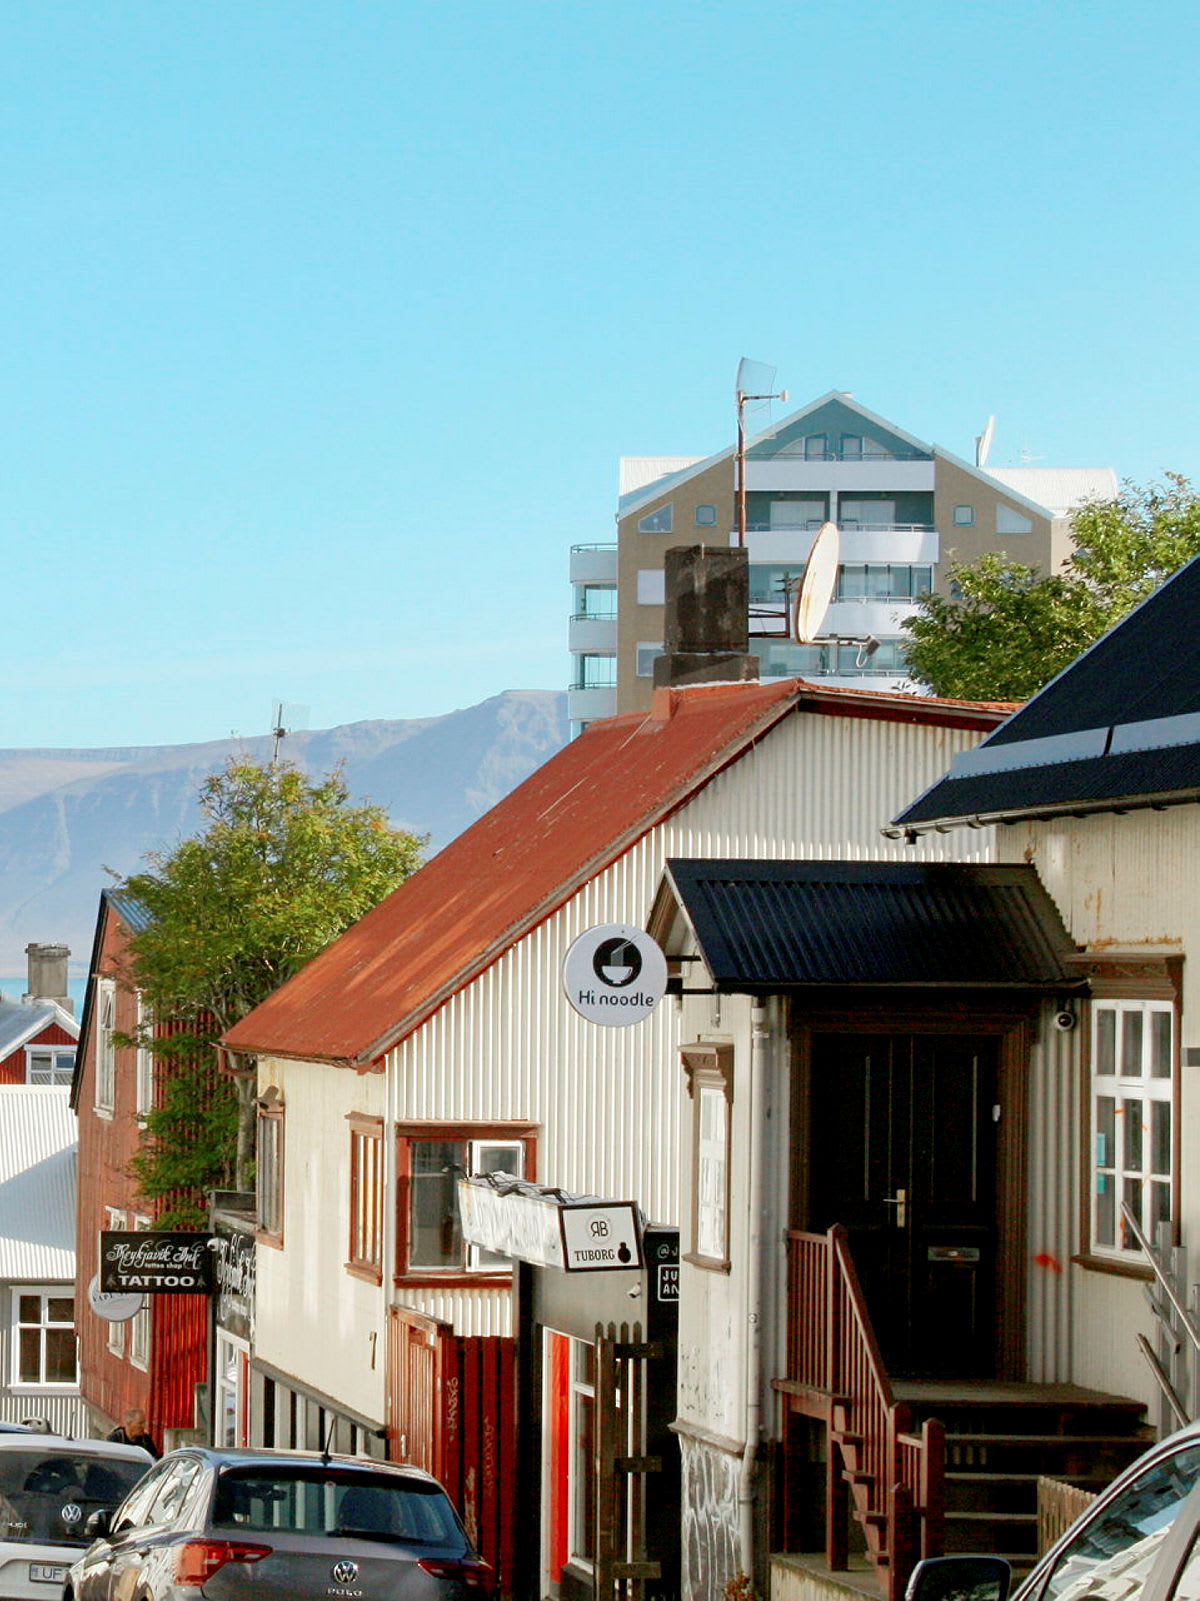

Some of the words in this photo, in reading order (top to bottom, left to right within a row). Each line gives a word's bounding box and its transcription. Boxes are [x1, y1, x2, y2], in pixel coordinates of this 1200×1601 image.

[579, 990, 596, 1005] Hi
[599, 992, 654, 1007] noodle
[172, 1241, 205, 1270] Ink
[574, 1249, 615, 1262] TUBORG
[118, 1275, 195, 1287] TATTOO
[662, 1270, 678, 1281] JU
[42, 1567, 69, 1580] UF
